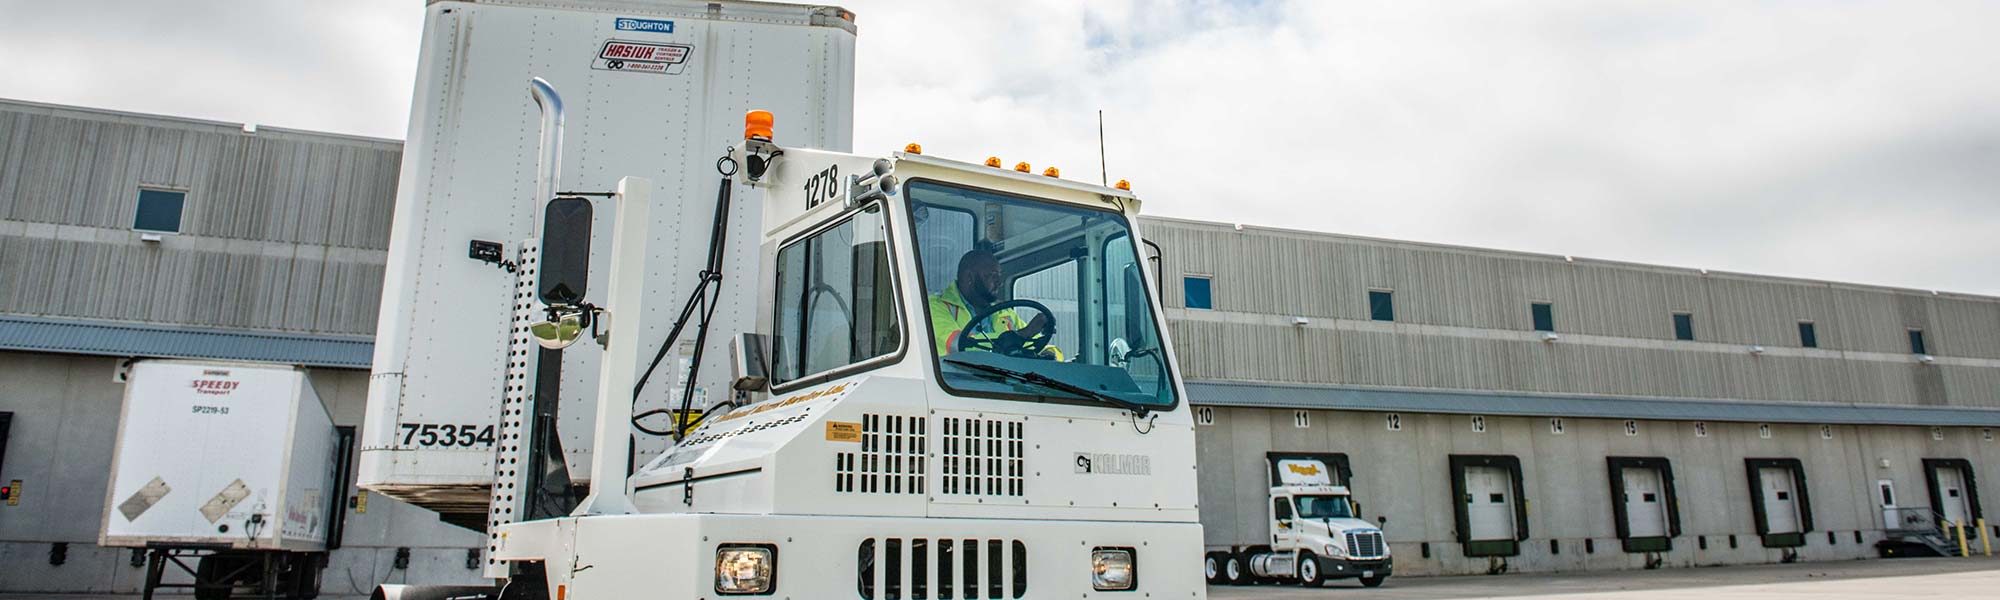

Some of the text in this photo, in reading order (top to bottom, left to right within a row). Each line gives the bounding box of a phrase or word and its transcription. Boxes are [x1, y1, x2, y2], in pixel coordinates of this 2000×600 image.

[618, 20, 670, 31] STOUGHTON
[605, 44, 656, 60] HASIUK
[804, 164, 838, 211] 1278
[192, 380, 240, 390] SPEEDY
[1199, 407, 1212, 424] 10
[1296, 411, 1308, 426] 11
[1387, 414, 1400, 429] 12
[1472, 417, 1484, 431] 13
[1552, 419, 1562, 433] 14
[1625, 420, 1635, 434] 15
[401, 423, 496, 447] 75354
[1093, 453, 1151, 475] KALMAR
